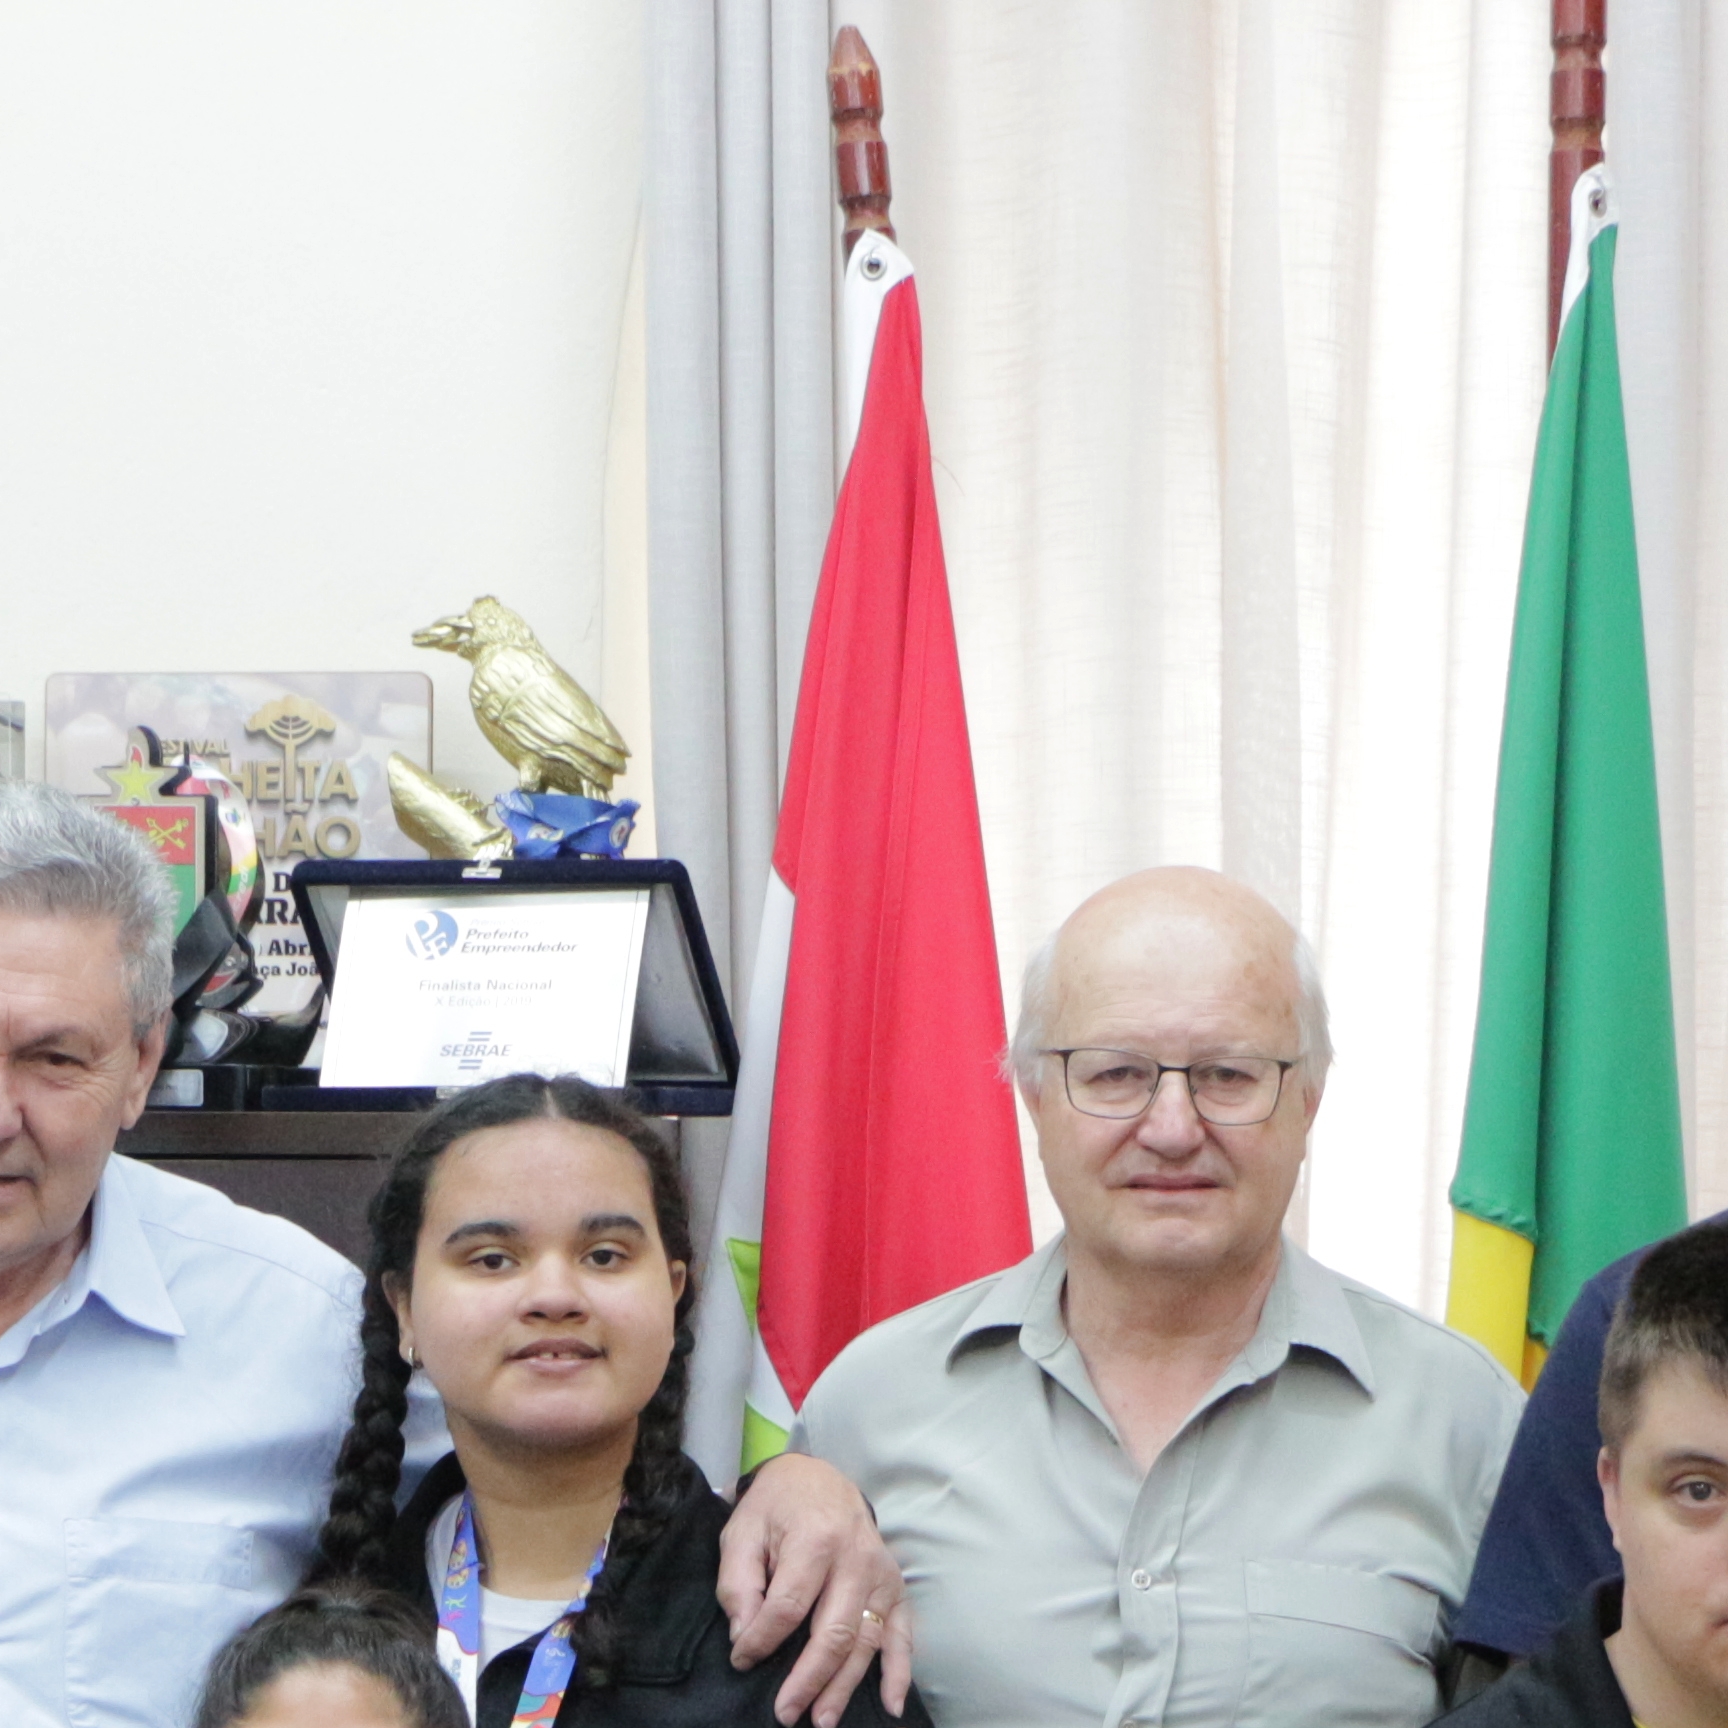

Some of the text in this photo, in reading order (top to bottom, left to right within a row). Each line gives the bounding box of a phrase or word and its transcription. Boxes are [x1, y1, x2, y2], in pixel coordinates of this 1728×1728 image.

[465, 928, 529, 940] Prefeito
[460, 941, 578, 956] Empreendedor
[419, 979, 552, 991] Finalista Nacional
[448, 995, 491, 1009] Edição
[439, 1043, 513, 1057] SEBRAE
